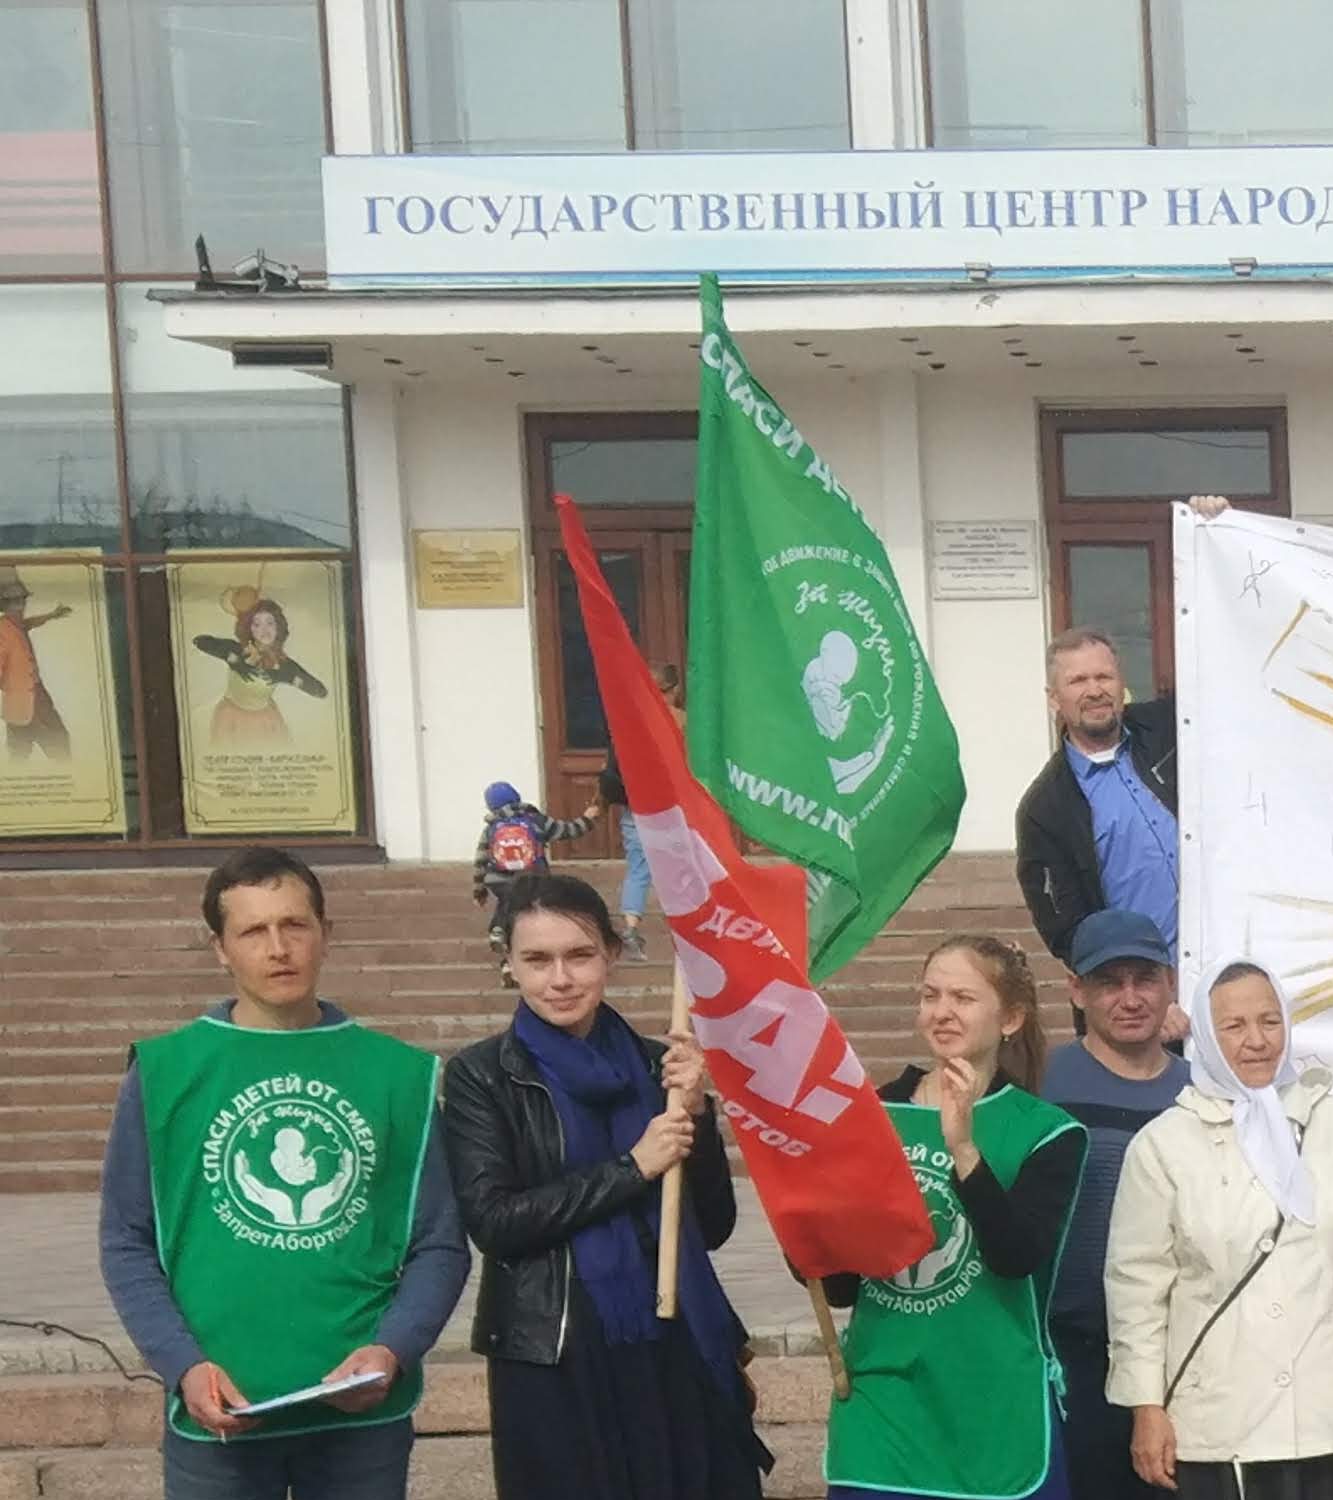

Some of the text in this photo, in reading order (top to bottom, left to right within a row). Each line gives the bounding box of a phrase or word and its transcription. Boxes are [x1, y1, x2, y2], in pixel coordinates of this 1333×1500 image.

[363, 182, 944, 240] ГОСУДАРСТВЕННЫЙ
[963, 187, 1148, 237] ЦЕНТР
[702, 332, 804, 458] СПАСИ
[203, 1073, 377, 1184] СПАСИ ДЕТЕЙ ОТ СМЕРТИ
